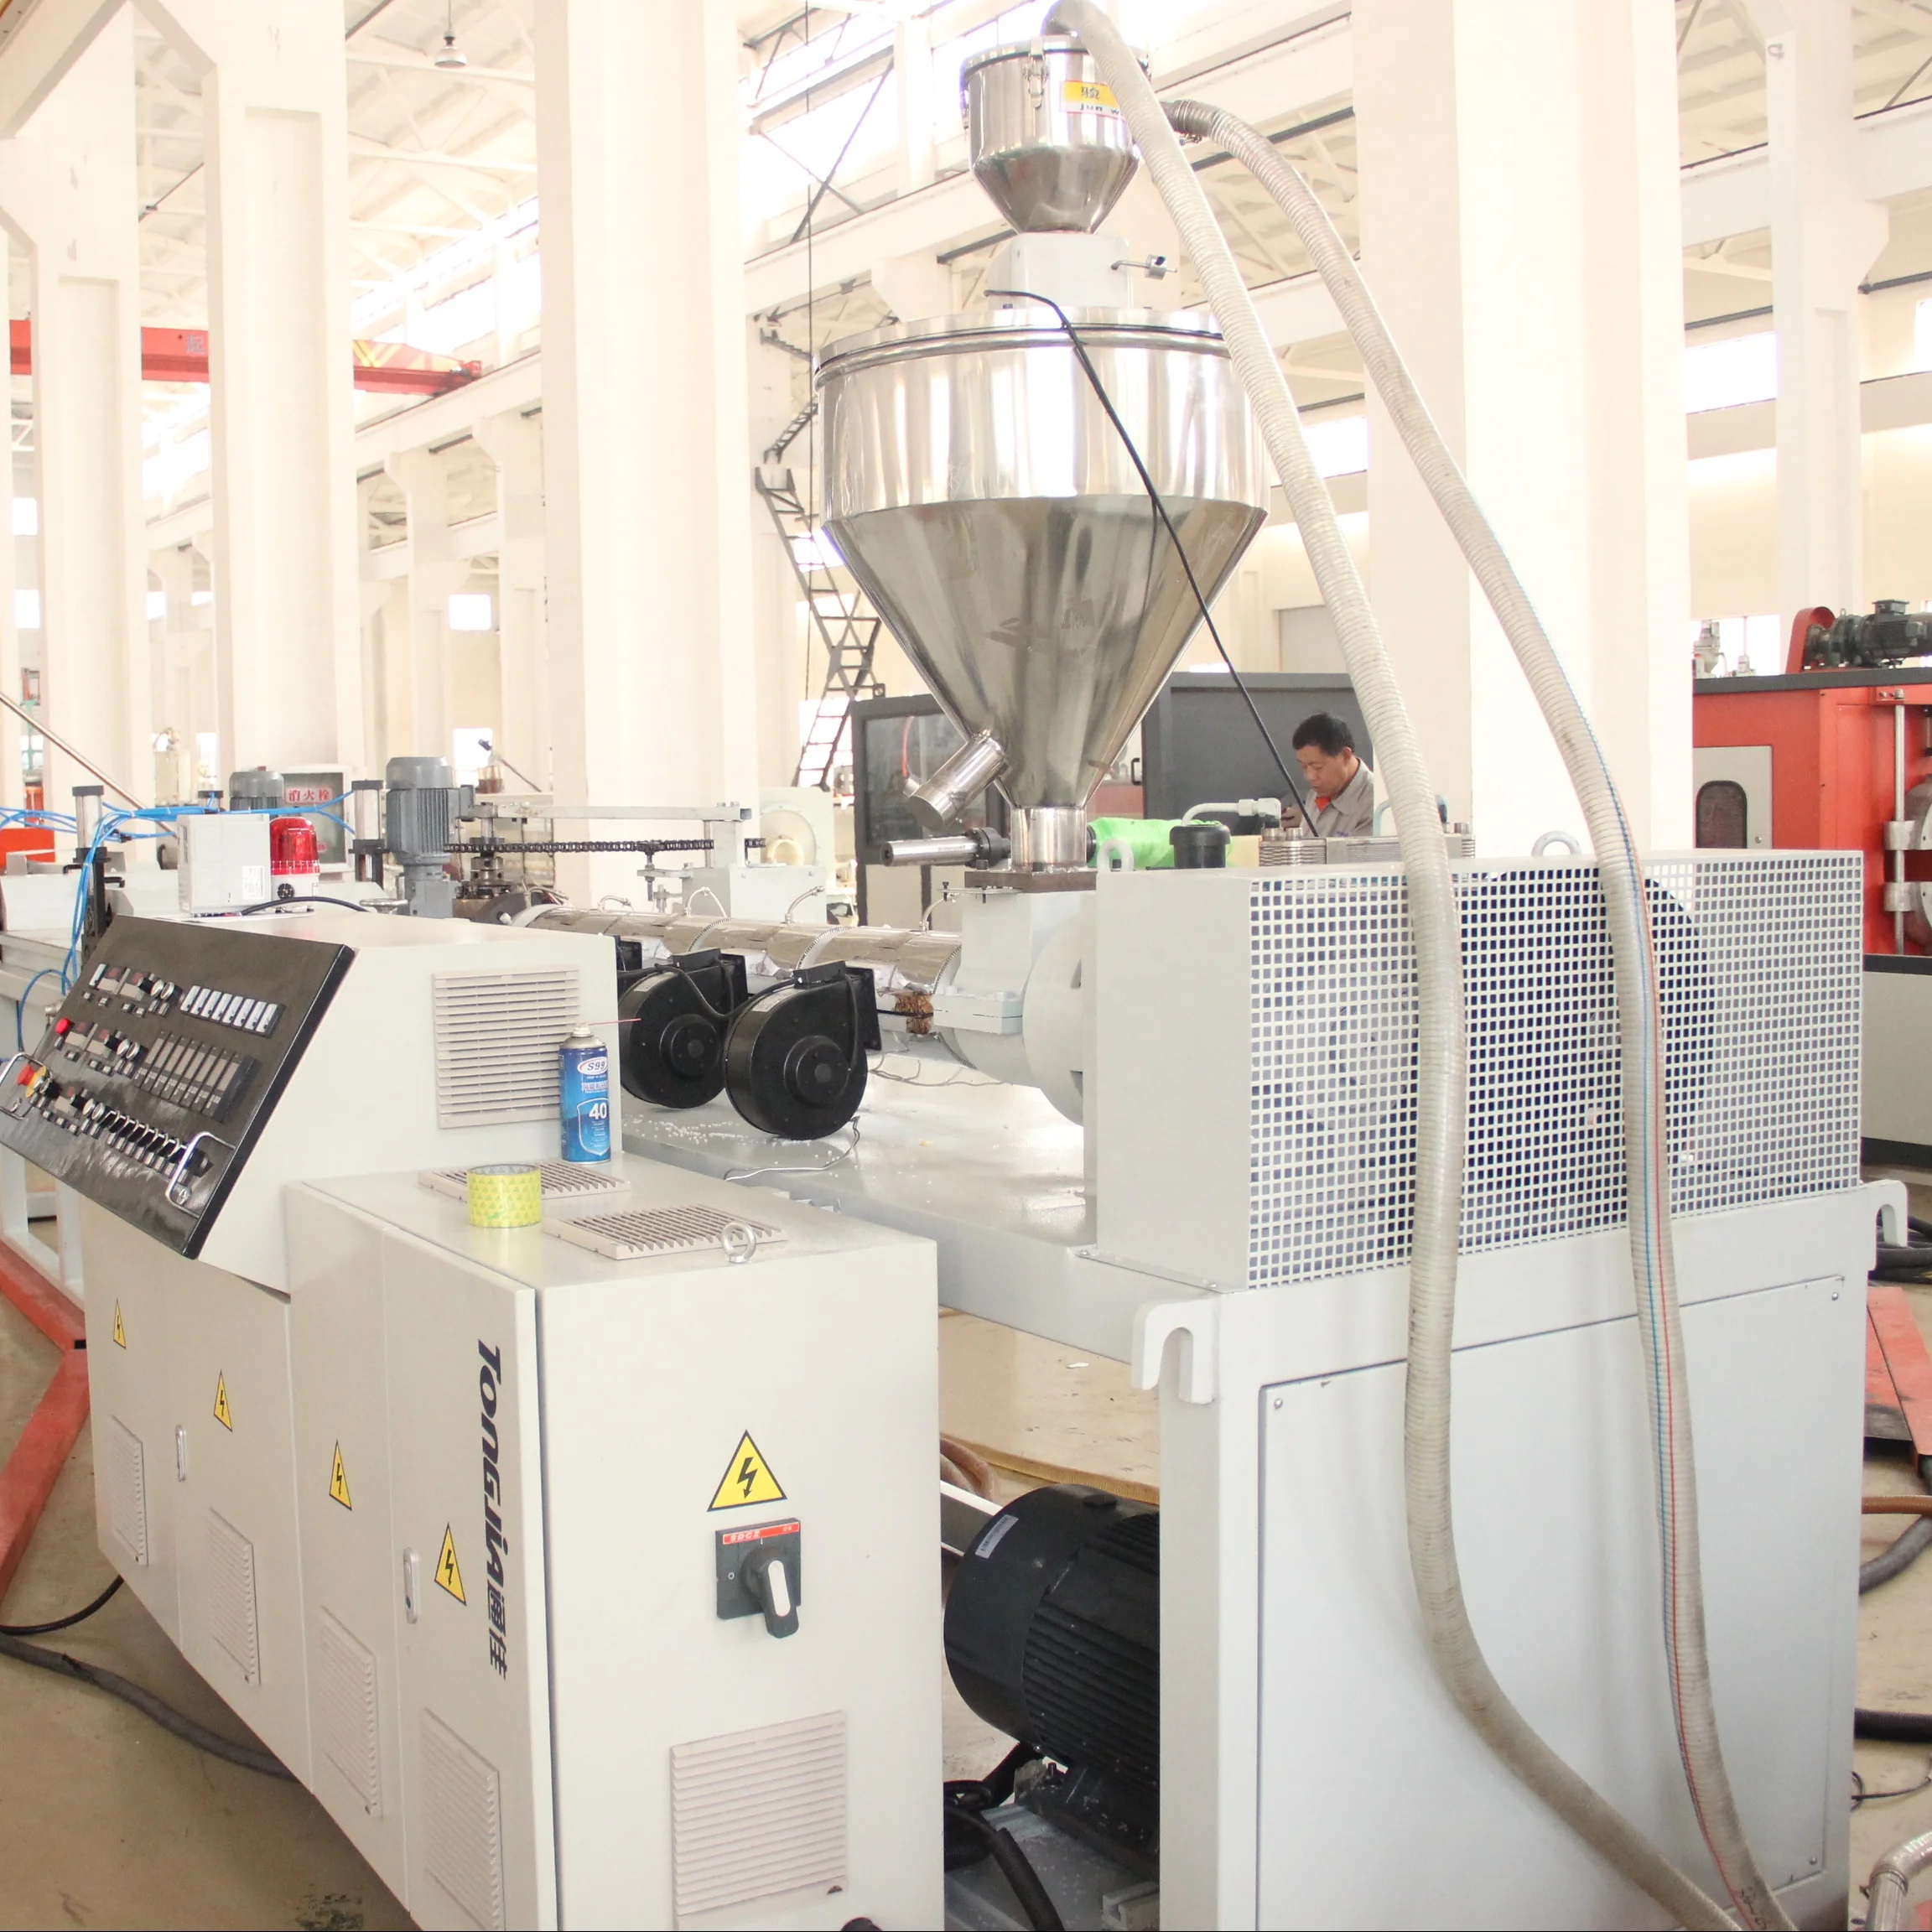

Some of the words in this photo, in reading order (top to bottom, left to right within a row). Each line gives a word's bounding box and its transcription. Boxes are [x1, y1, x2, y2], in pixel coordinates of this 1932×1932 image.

[288, 789, 330, 802] 消火栓
[587, 1061, 605, 1071] S99
[589, 1102, 607, 1120] 40
[487, 1579, 507, 1681] 通佳
